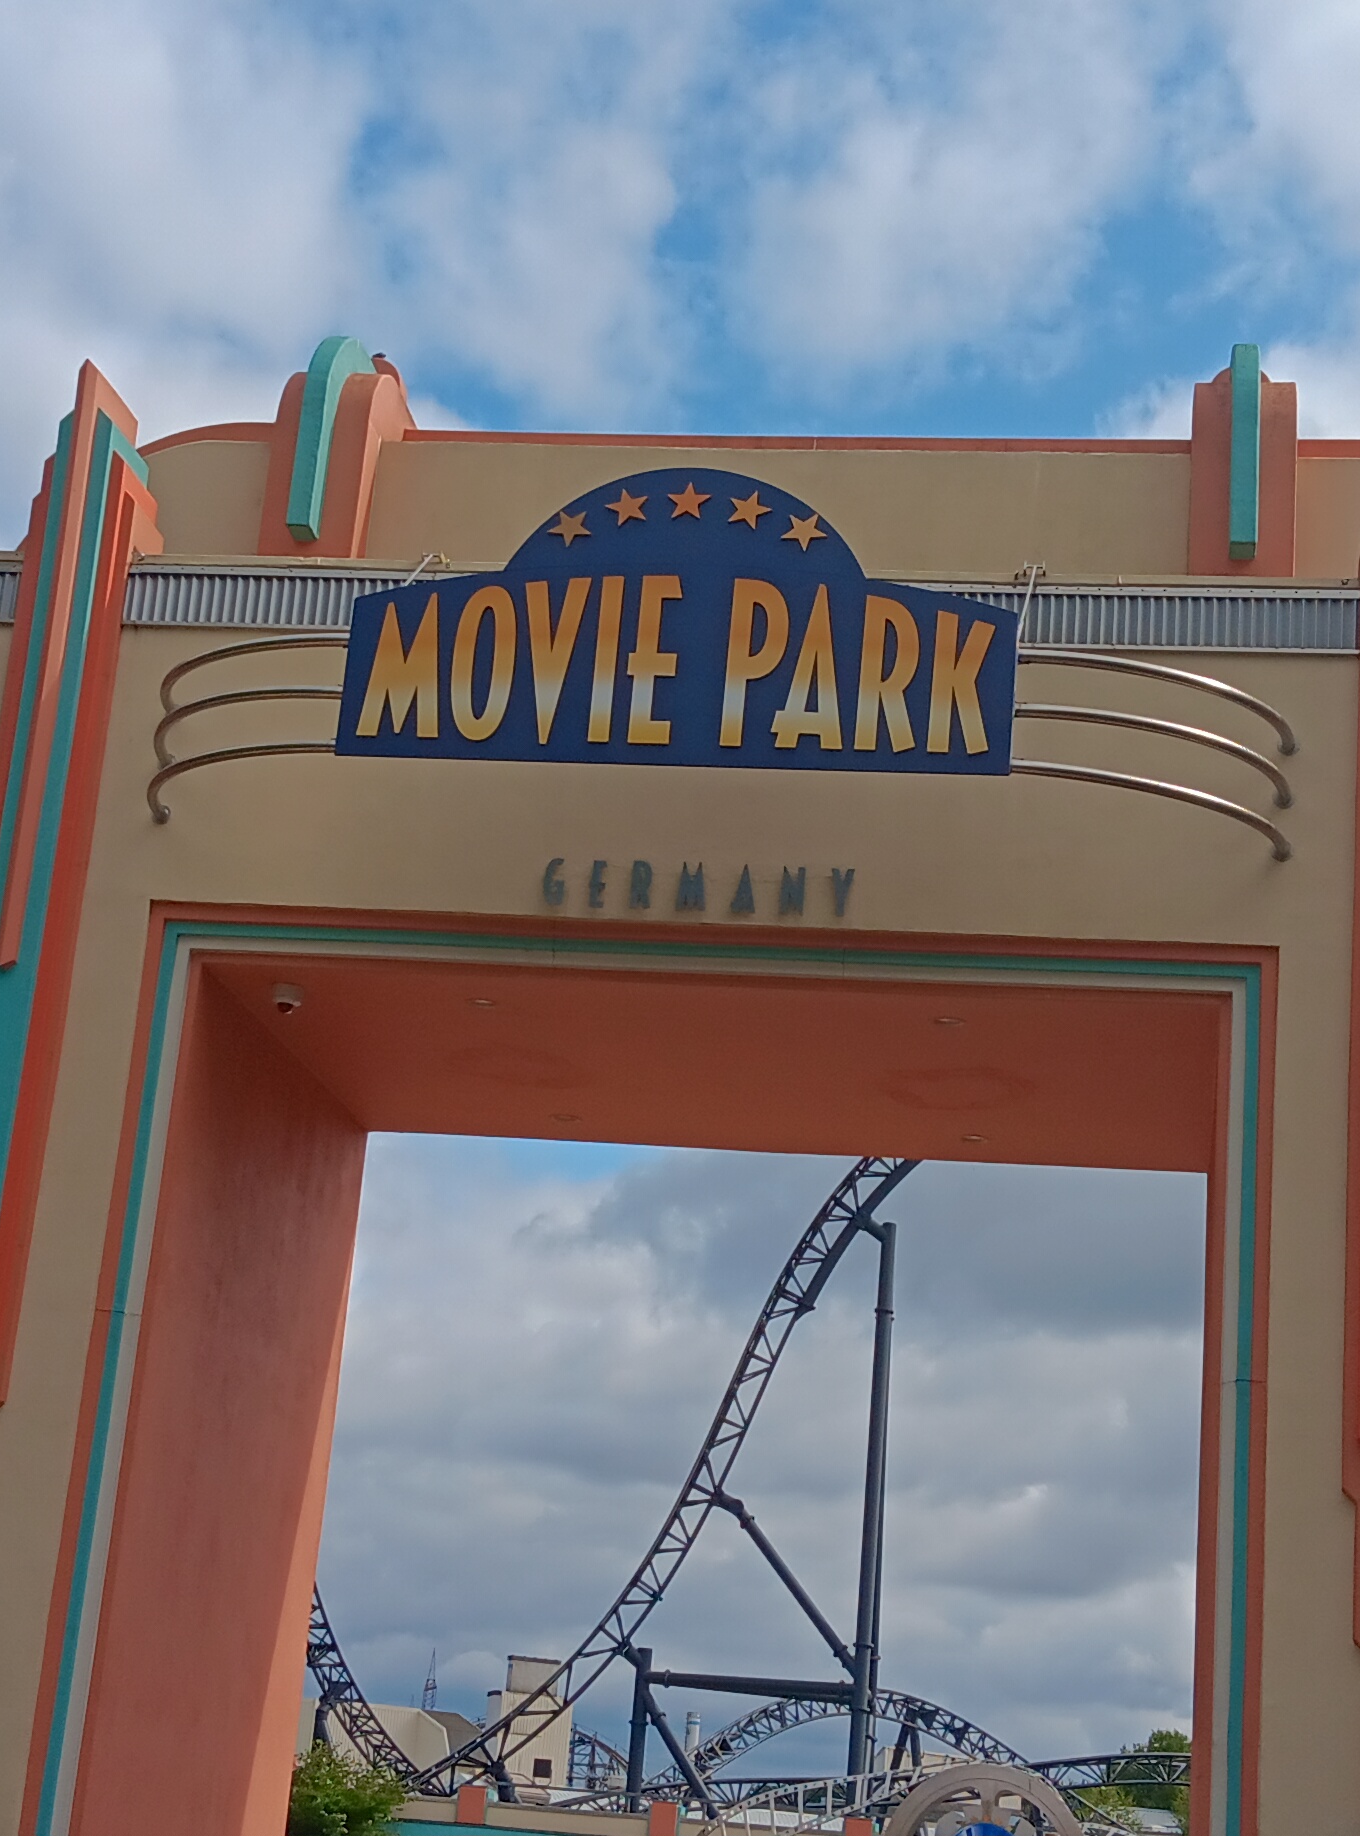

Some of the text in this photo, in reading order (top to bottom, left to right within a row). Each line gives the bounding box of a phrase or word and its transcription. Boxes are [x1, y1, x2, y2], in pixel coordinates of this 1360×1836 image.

[356, 575, 996, 755] MOVIE PARK
[542, 858, 855, 917] GERMANY
